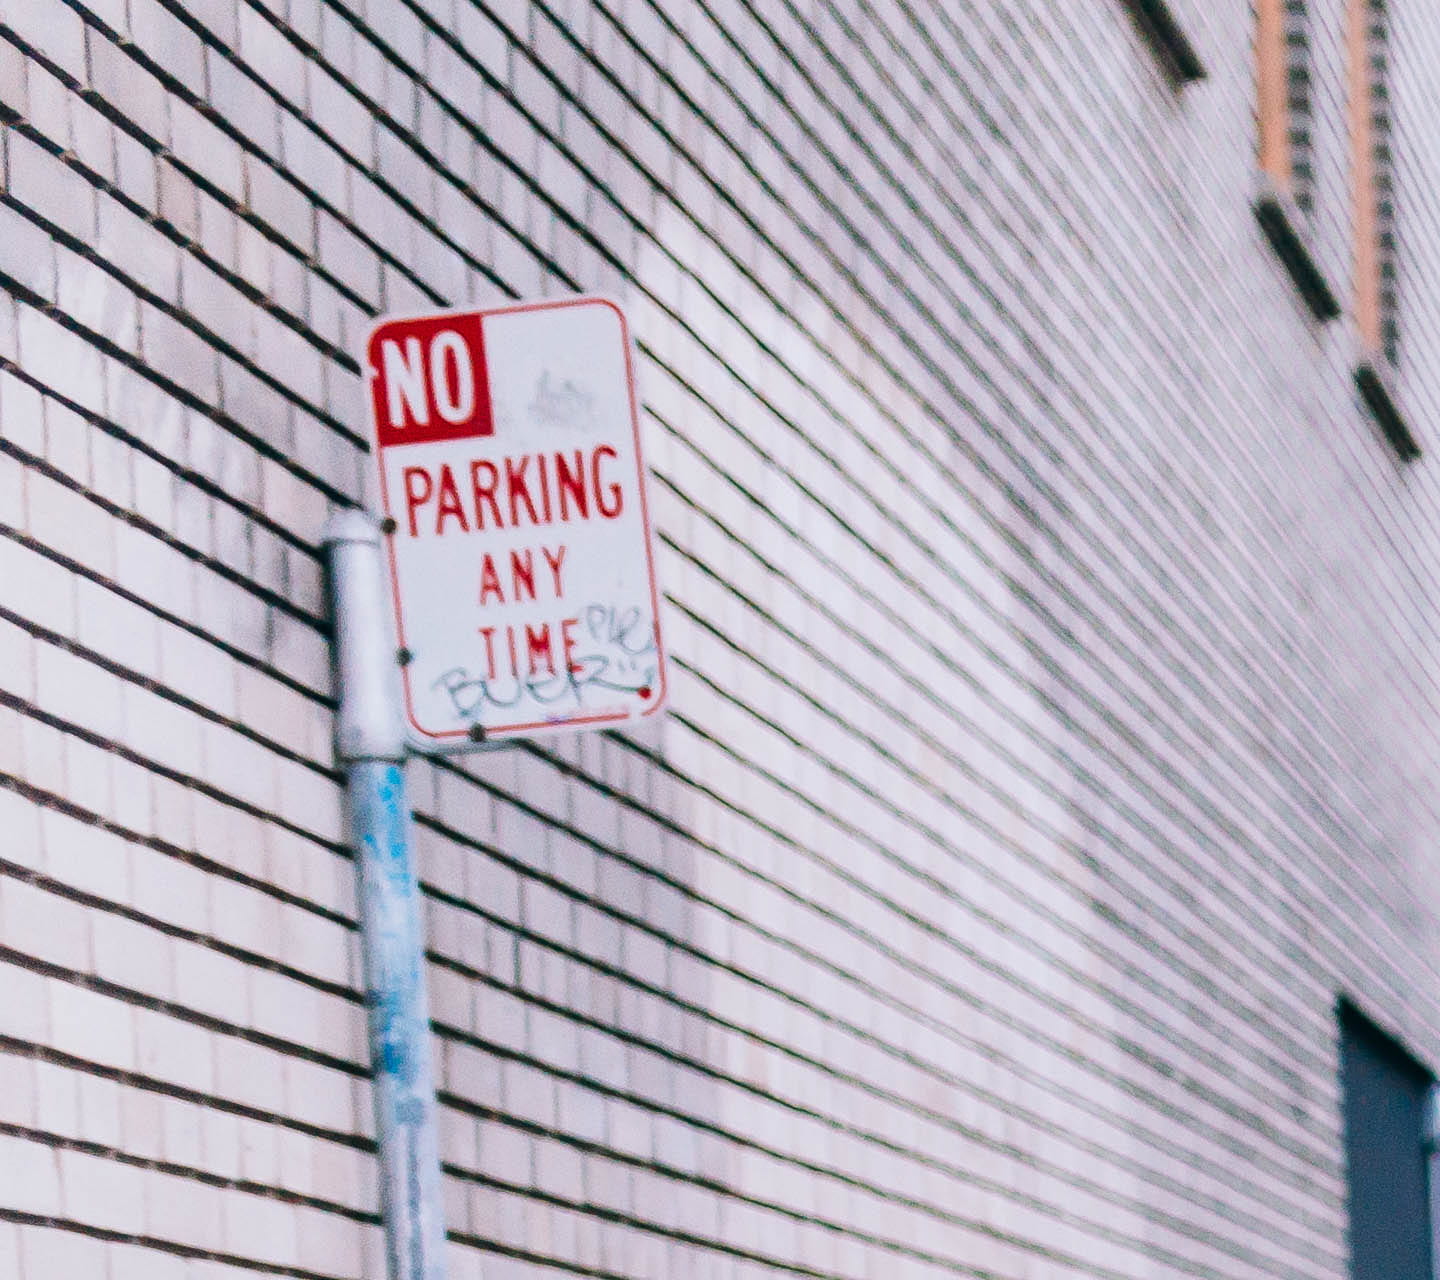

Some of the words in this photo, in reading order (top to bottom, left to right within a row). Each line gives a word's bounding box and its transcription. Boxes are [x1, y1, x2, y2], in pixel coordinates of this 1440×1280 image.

[380, 330, 477, 428] NO
[403, 444, 625, 538] PARKING
[480, 545, 567, 606] ANY
[478, 617, 584, 681] TIME
